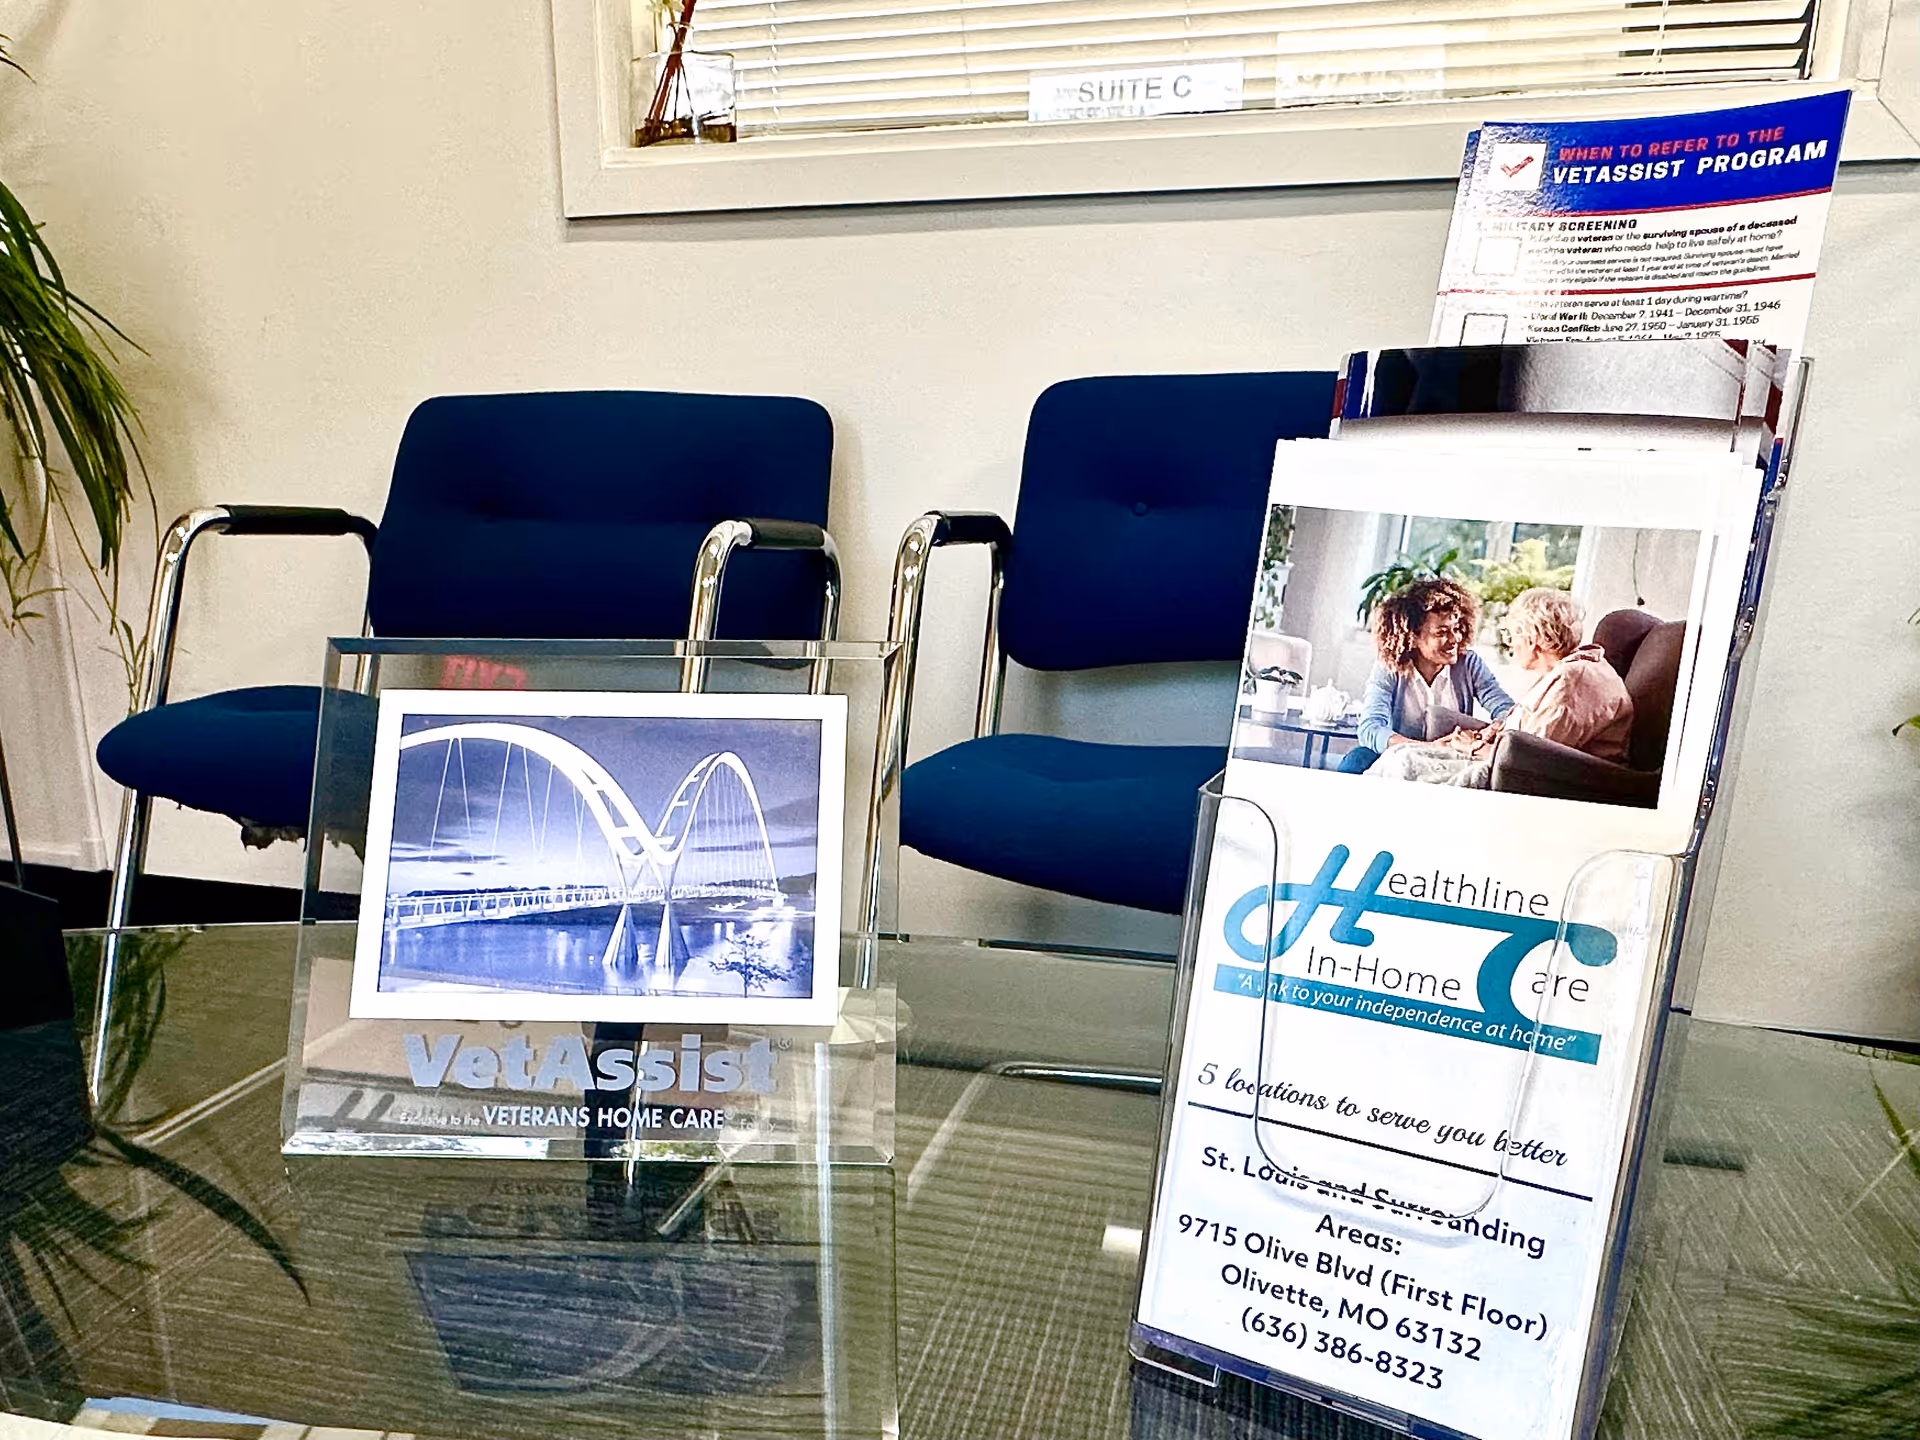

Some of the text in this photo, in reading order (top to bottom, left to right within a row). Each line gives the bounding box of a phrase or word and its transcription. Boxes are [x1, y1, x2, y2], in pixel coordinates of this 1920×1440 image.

[1078, 76, 1163, 103] SUITE
[1173, 74, 1192, 98] C
[1553, 139, 1828, 184] VETASSIST PROGRAM
[1558, 126, 1785, 161] WHEN TO REFER TO THE
[1558, 219, 1638, 231] SCREENING
[1567, 246, 1602, 254] veteran
[1624, 242, 1651, 251] needs
[1656, 241, 1674, 250] help
[1677, 240, 1686, 248] to
[1688, 238, 1705, 247] live
[1707, 235, 1735, 246] safely
[1737, 235, 1747, 243] at
[1749, 229, 1783, 241] home?
[1626, 232, 1641, 240] the
[1643, 229, 1687, 240] surviving
[1689, 227, 1724, 237] spouse
[1727, 222, 1738, 232] of
[1747, 215, 1798, 229] deceased
[1559, 312, 1578, 320] War
[1591, 311, 1636, 319] December
[1649, 309, 1673, 318] 1941
[1685, 305, 1733, 316] December
[1611, 299, 1620, 307] at
[1621, 297, 1645, 305] least
[1655, 296, 1672, 305] day
[1673, 294, 1702, 304] during
[1703, 290, 1748, 302] wartime?
[1602, 324, 1623, 332] June
[1677, 320, 1713, 329] January
[1307, 946, 1461, 1001] In-Home
[1292, 984, 1310, 1000] to
[1311, 991, 1354, 1009] your
[1355, 995, 1483, 1034] independence
[1485, 1022, 1507, 1039] at
[403, 1033, 778, 1092] VetAssist
[451, 1113, 461, 1126] to
[464, 1113, 480, 1126] the
[483, 1105, 590, 1128] VETERANS
[598, 1106, 663, 1129] HOME
[669, 1108, 724, 1129] CARE
[1198, 1062, 1568, 1166] 5 locations to serve you better
[1202, 1146, 1235, 1172] St.
[1243, 1155, 1309, 1190] Louis
[1373, 1188, 1545, 1260] Surrounding
[1315, 1214, 1402, 1255] Areas:
[1178, 1214, 1547, 1341] 9715 Olive Blvd (First Floor)
[1221, 1264, 1482, 1361] Olivette, MO 63132
[1242, 1306, 1443, 1389] (636) 386-8323
